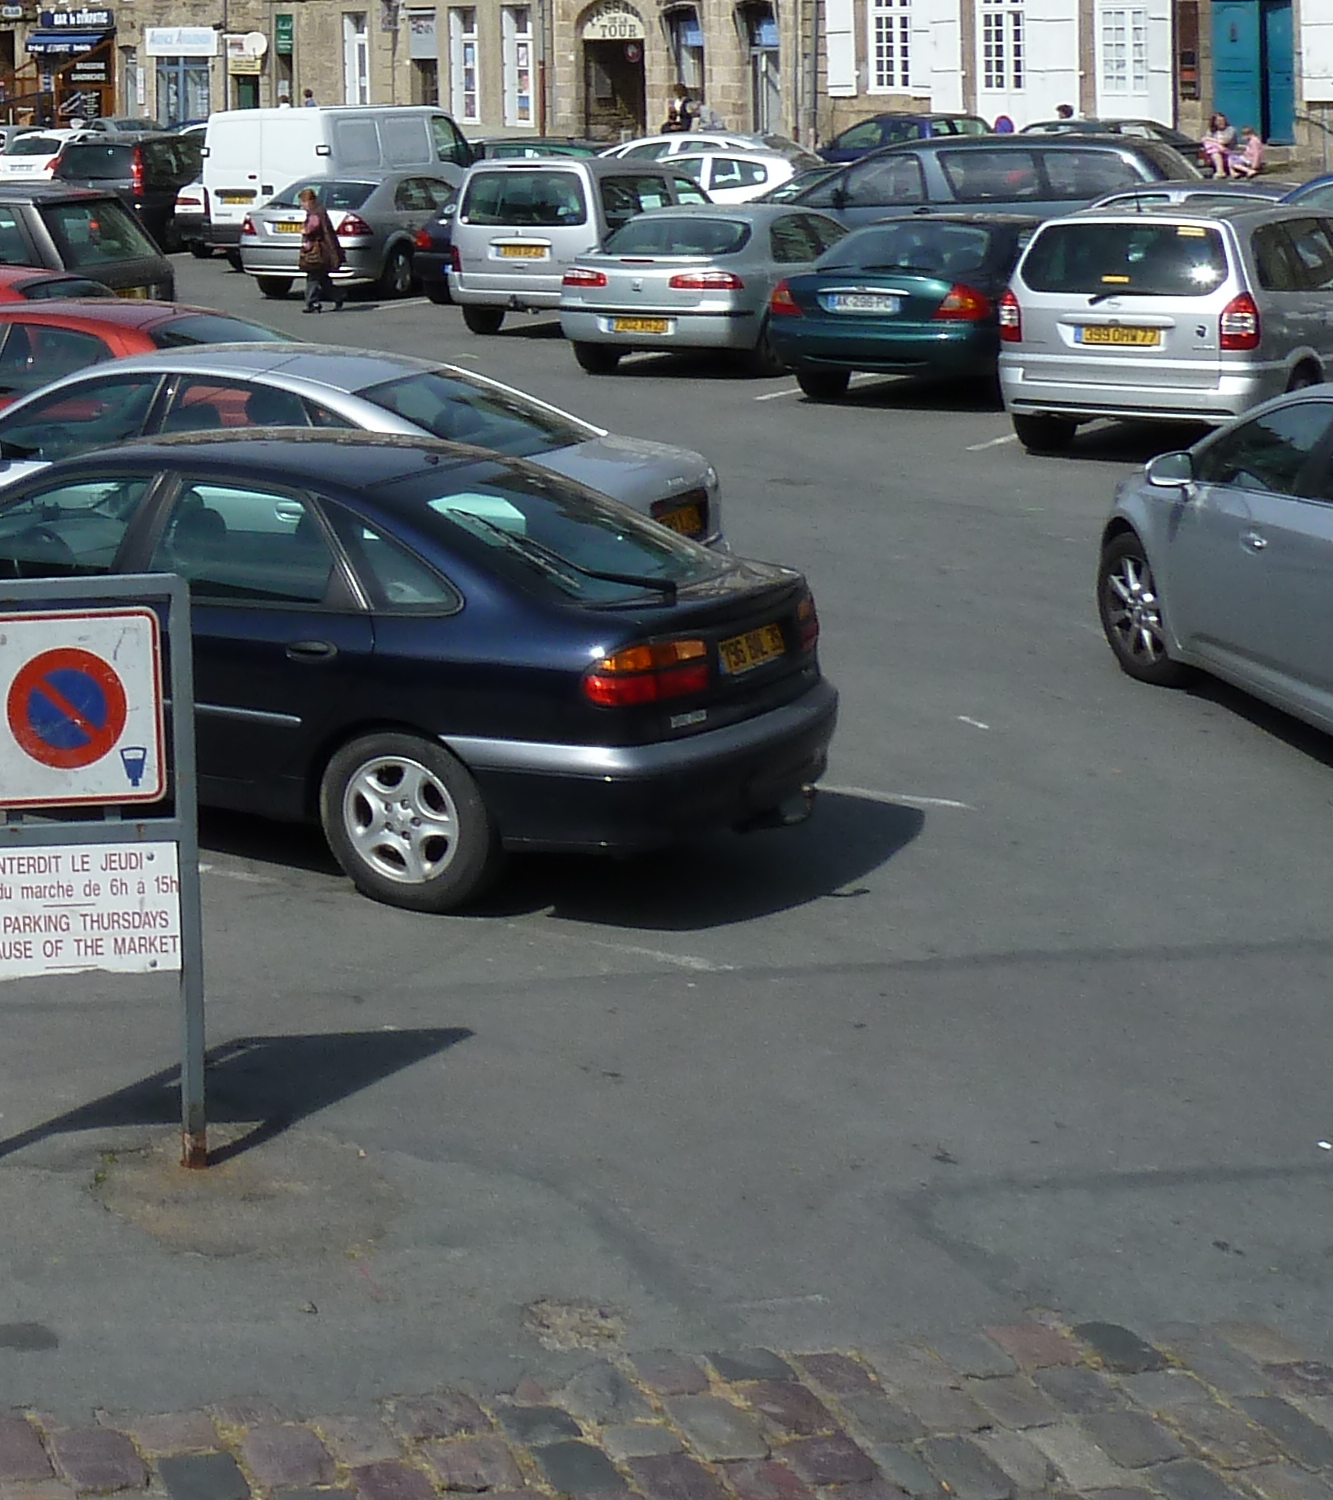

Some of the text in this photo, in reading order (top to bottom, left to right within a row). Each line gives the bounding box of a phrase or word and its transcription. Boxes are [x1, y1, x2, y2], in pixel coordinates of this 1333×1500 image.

[599, 24, 637, 37] TOUR
[1139, 328, 1156, 343] 77
[71, 854, 90, 873] LE
[100, 852, 143, 872] JEUDI
[21, 879, 74, 899] marché
[83, 879, 101, 897] de
[110, 877, 129, 896] 6h
[154, 875, 179, 894] 15h
[3, 914, 70, 934] PARKING
[79, 910, 169, 931] THURSDAYS
[43, 939, 63, 958] OF
[73, 938, 104, 956] THE
[114, 935, 179, 955] MARKET
